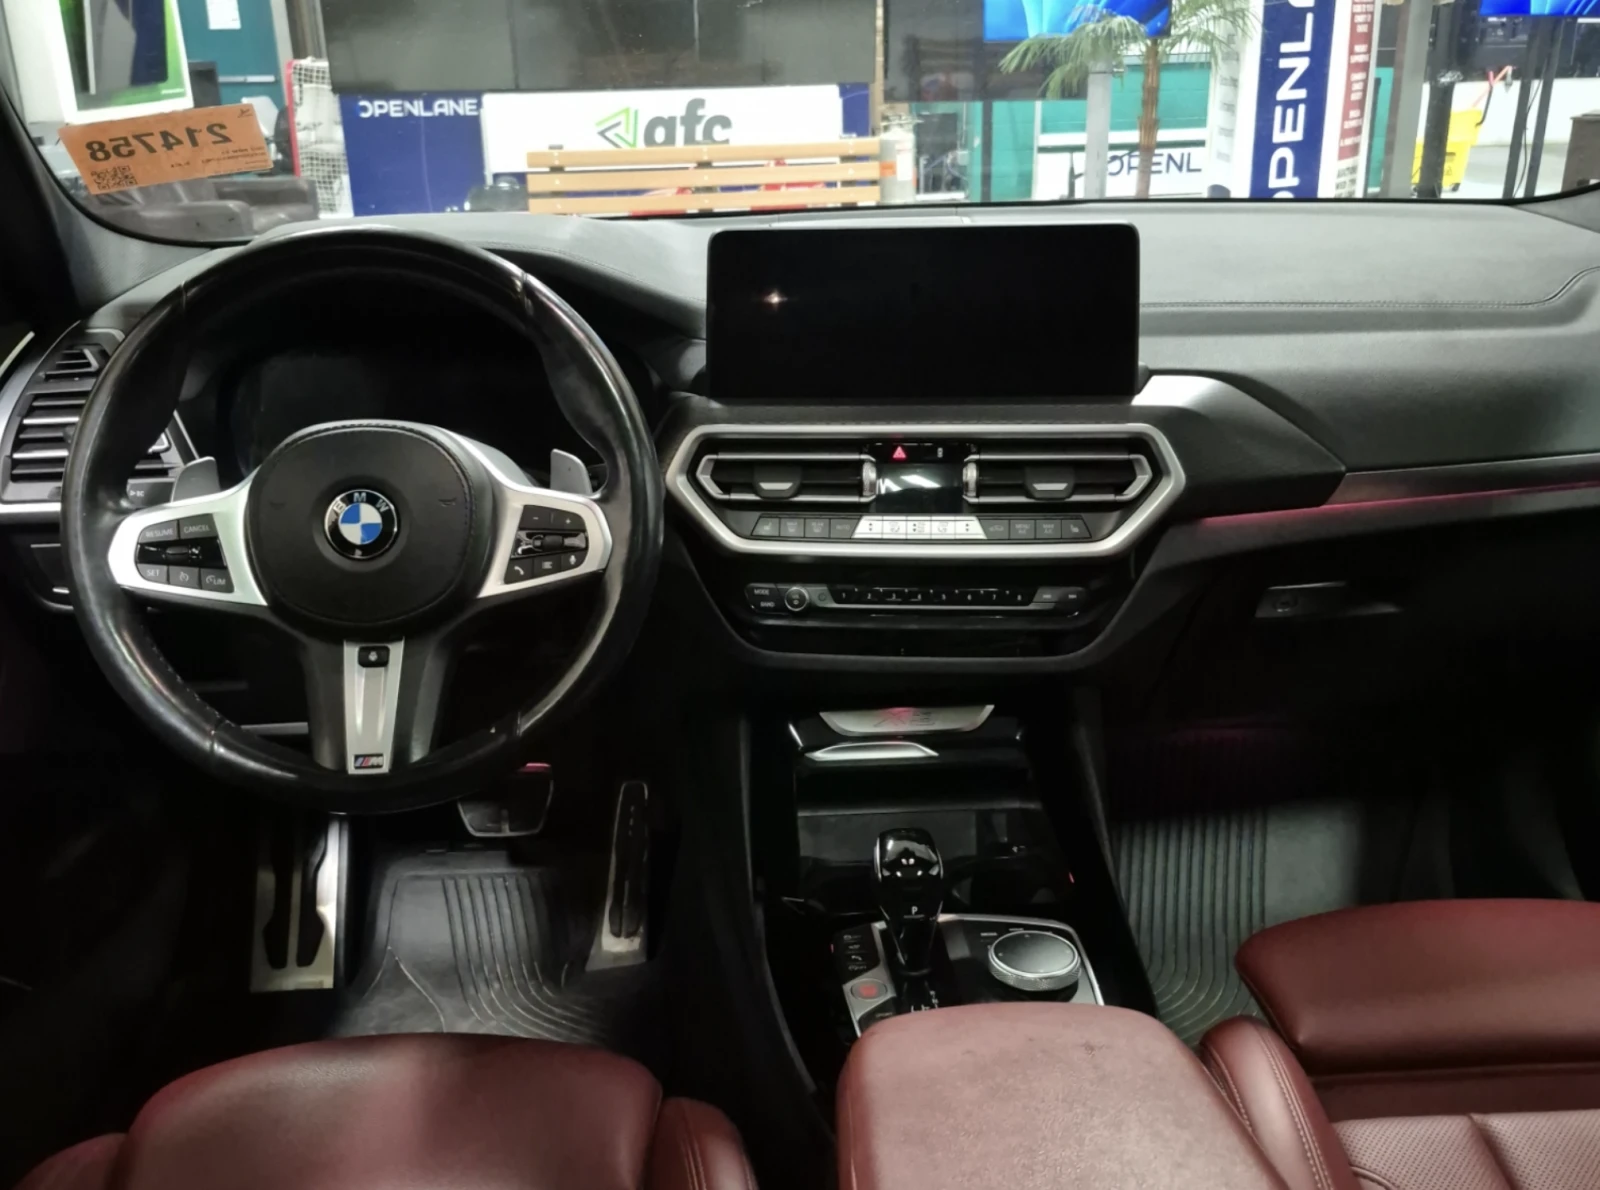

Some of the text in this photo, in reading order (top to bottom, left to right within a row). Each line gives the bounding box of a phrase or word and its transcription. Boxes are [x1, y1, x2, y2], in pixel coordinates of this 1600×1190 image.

[357, 98, 479, 118] OPENLANE
[643, 97, 733, 148] afc
[333, 491, 390, 514] BMW
[145, 528, 174, 538] RESUME
[183, 524, 211, 533] CANCEL
[146, 569, 160, 577] SET
[754, 588, 770, 596] MODE
[911, 905, 918, 915] P
